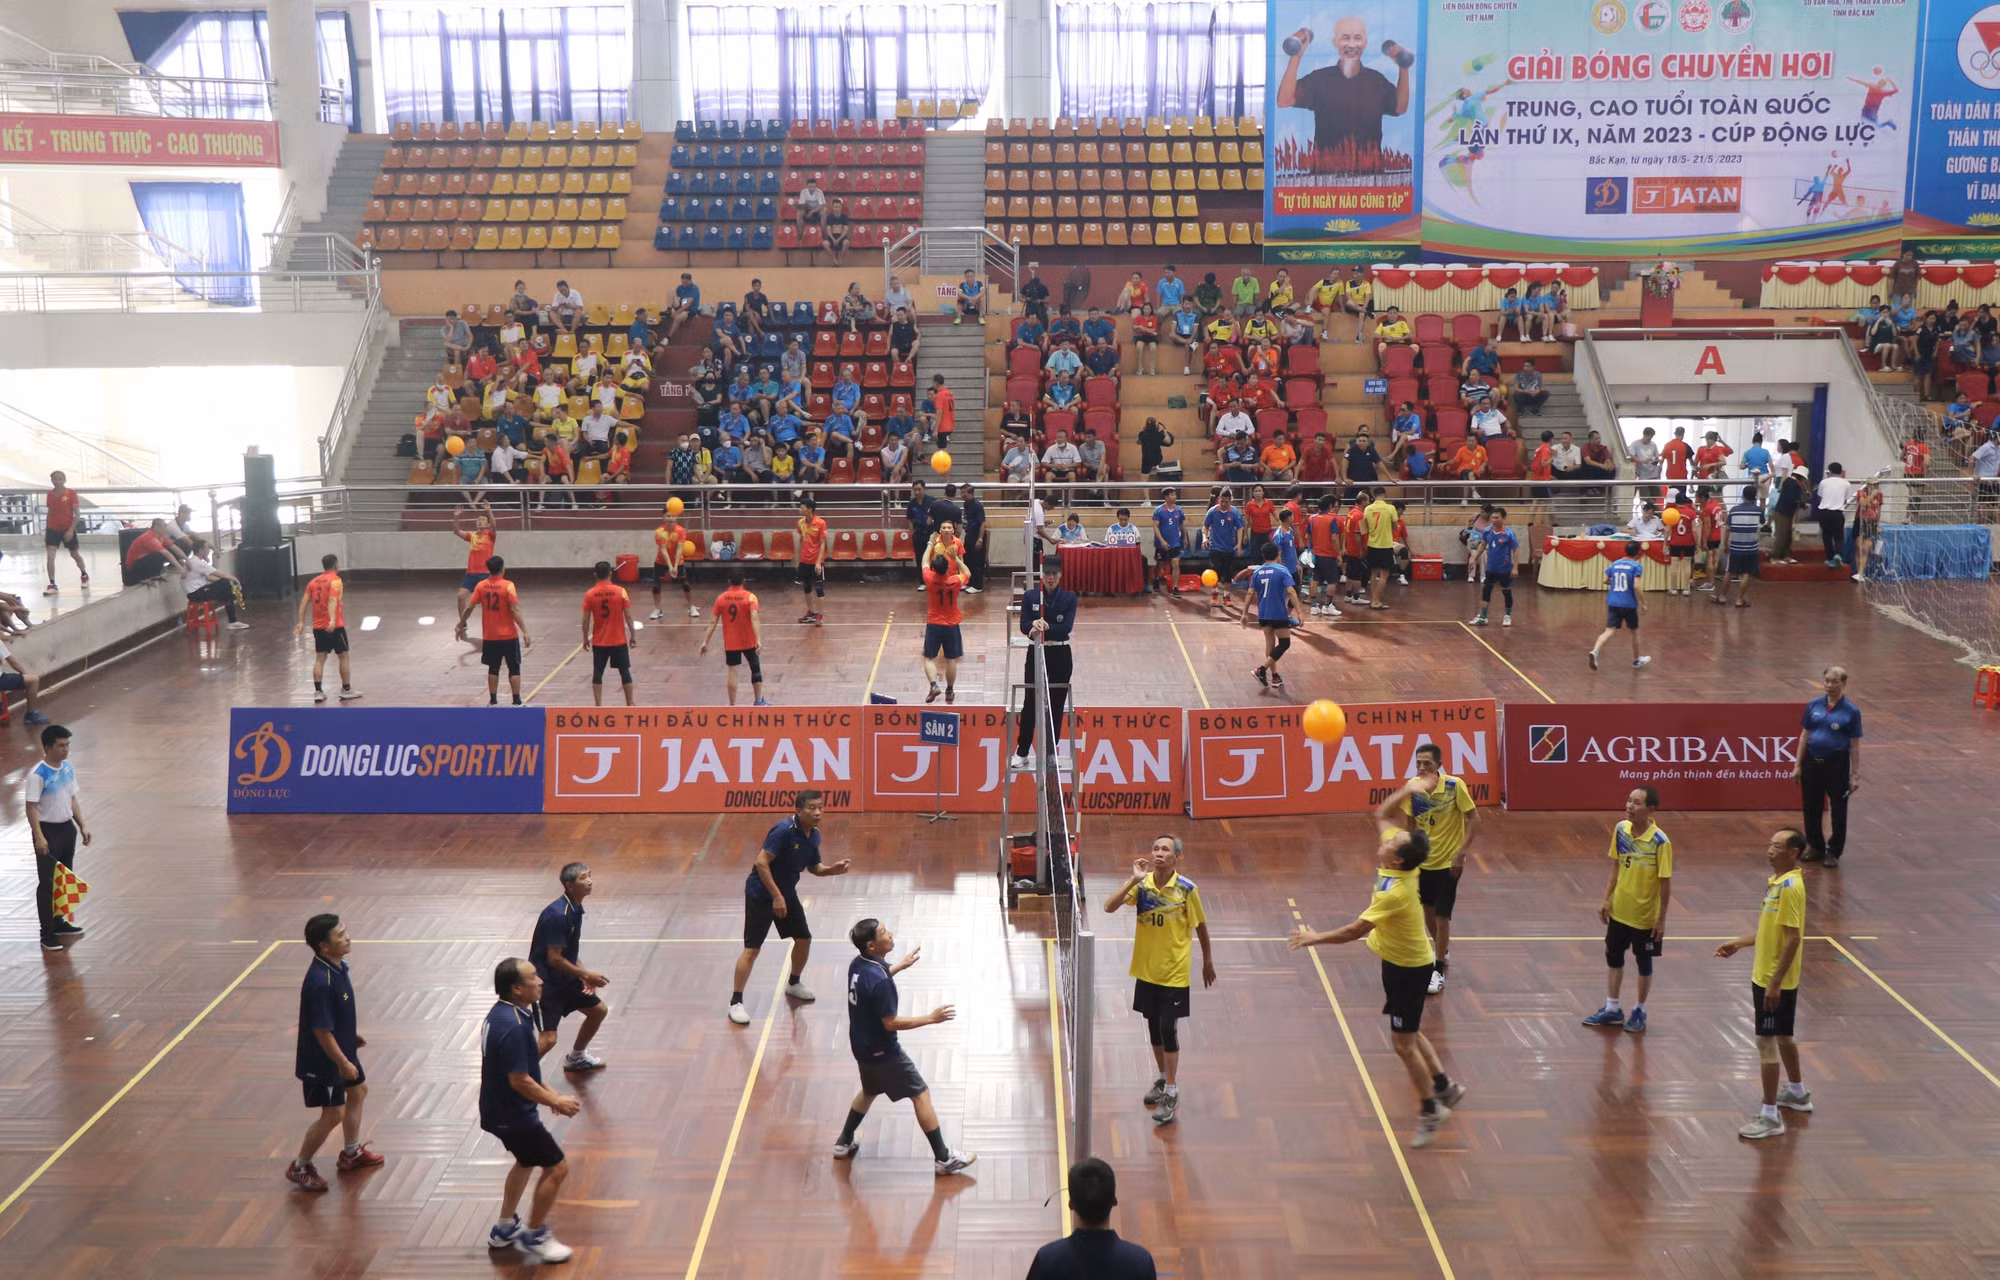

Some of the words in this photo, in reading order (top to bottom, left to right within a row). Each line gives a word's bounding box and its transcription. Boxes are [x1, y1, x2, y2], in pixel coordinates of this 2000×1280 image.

[1507, 48, 1562, 80] GIẢI
[1572, 50, 1651, 80] BÓNG
[1661, 45, 1770, 79] CHUYỀN
[1781, 52, 1832, 78] HƠI
[1506, 100, 1582, 119] TRUNG,
[1589, 99, 1638, 116] CAO
[1646, 90, 1693, 116] TUỔI
[1699, 93, 1757, 116] TOÀN
[1765, 91, 1831, 115] QUỐC
[1930, 100, 1962, 120] TOÀN
[1965, 100, 1990, 120] DÂN
[2, 121, 34, 152] KẾT
[50, 129, 106, 153] TRUNG
[109, 129, 152, 158] THỰC
[167, 132, 199, 156] CAO
[203, 131, 264, 161] THƯỢNG
[1459, 119, 1499, 145] LẦN
[1506, 124, 1547, 145] THỨ
[1552, 127, 1580, 147] IX,
[1587, 123, 1636, 144] NĂM
[1643, 126, 1693, 144] 2023
[1711, 120, 1756, 143] CÚP
[1762, 121, 1828, 147] ĐỘNG
[1835, 123, 1876, 146] LỰC
[1947, 127, 1980, 147] THÂN
[1589, 155, 1606, 165] Bắc
[1642, 155, 1664, 166] ngày
[1946, 155, 1988, 174] GƯƠNG
[1671, 187, 1738, 207] JATAN
[1967, 181, 1979, 200] VĨ
[1297, 193, 1311, 209] TÔI
[1312, 192, 1337, 209] NGÀY
[1339, 192, 1358, 209] NÀO
[1360, 192, 1385, 209] CŨNG
[1695, 345, 1726, 376] A
[1671, 449, 1676, 465] 1
[1372, 511, 1381, 529] 7
[1677, 519, 1687, 535] 6
[1260, 578, 1270, 599] 7
[1613, 572, 1628, 592] 10
[486, 591, 500, 611] 12
[601, 599, 610, 619] 5
[728, 604, 738, 623] 9
[556, 711, 617, 728] BÓNG
[624, 714, 659, 728] THI
[666, 710, 708, 728] ĐẤU
[717, 711, 786, 728] CHÍNH
[793, 711, 851, 728] THỨC
[874, 710, 917, 726] BÓN
[1112, 711, 1171, 728] THỨC
[1199, 713, 1259, 730] BÓNG
[1267, 714, 1299, 728] THI
[1357, 708, 1422, 725] CHÍNH
[1430, 705, 1487, 722] THỨC
[925, 719, 945, 737] SÂN
[947, 724, 954, 738] 2
[1577, 736, 1799, 764] AGRIBANK
[300, 744, 539, 777] DONGLUCSPORT.VN
[571, 747, 621, 785] J
[658, 738, 851, 793] JATAN
[890, 745, 939, 783] J
[1218, 748, 1265, 787] J
[1619, 769, 1650, 781] Mang
[1684, 769, 1713, 781] thịnh
[1716, 769, 1736, 779] đến
[1738, 769, 1771, 779] khách
[233, 786, 265, 800] ĐỘNG
[724, 790, 851, 808] DONGLUCST.VN
[1429, 814, 1435, 826] 6
[1625, 856, 1631, 869] 5
[1152, 912, 1164, 927] 10
